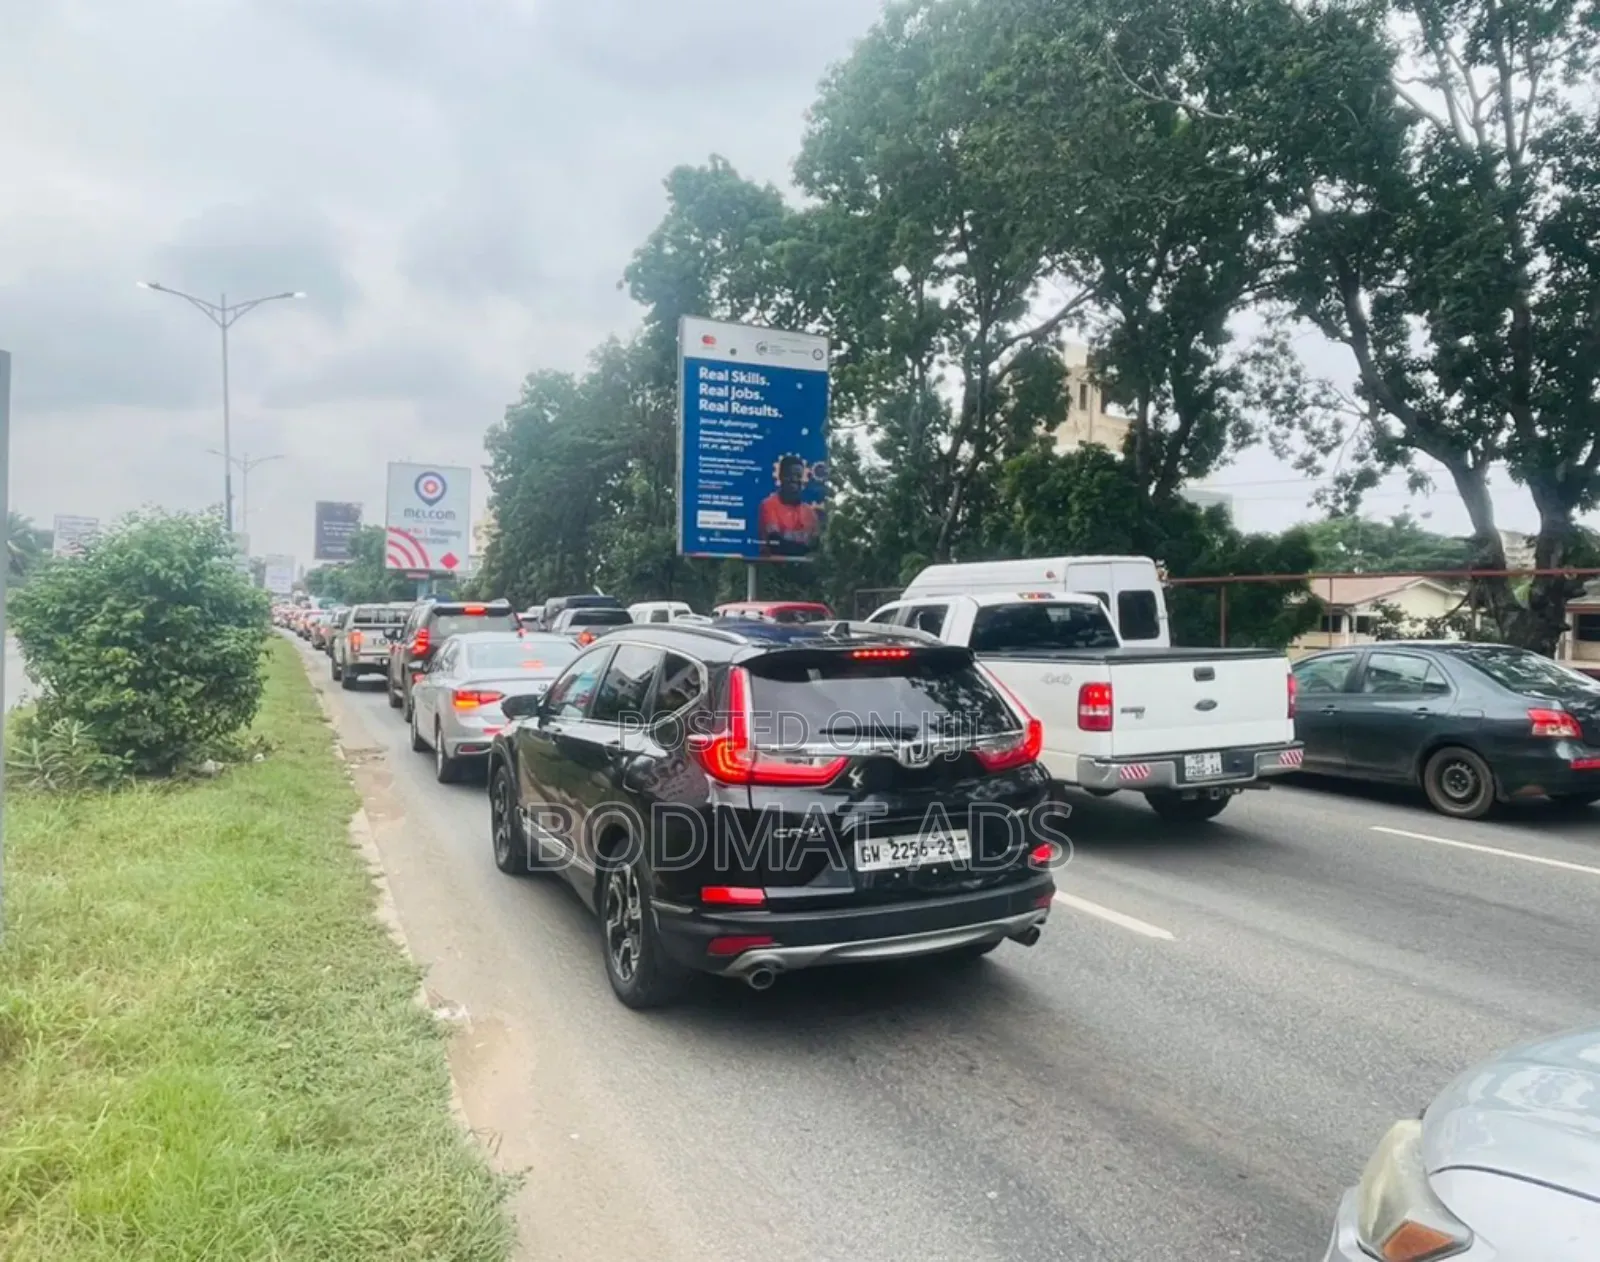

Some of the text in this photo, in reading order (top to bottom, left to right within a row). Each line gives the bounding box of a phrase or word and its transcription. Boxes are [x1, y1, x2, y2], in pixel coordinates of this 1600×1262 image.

[699, 366, 770, 387] Real Skills.
[699, 382, 764, 401] Real Jobs.
[699, 398, 783, 418] Real Results.
[861, 846, 881, 864] GW
